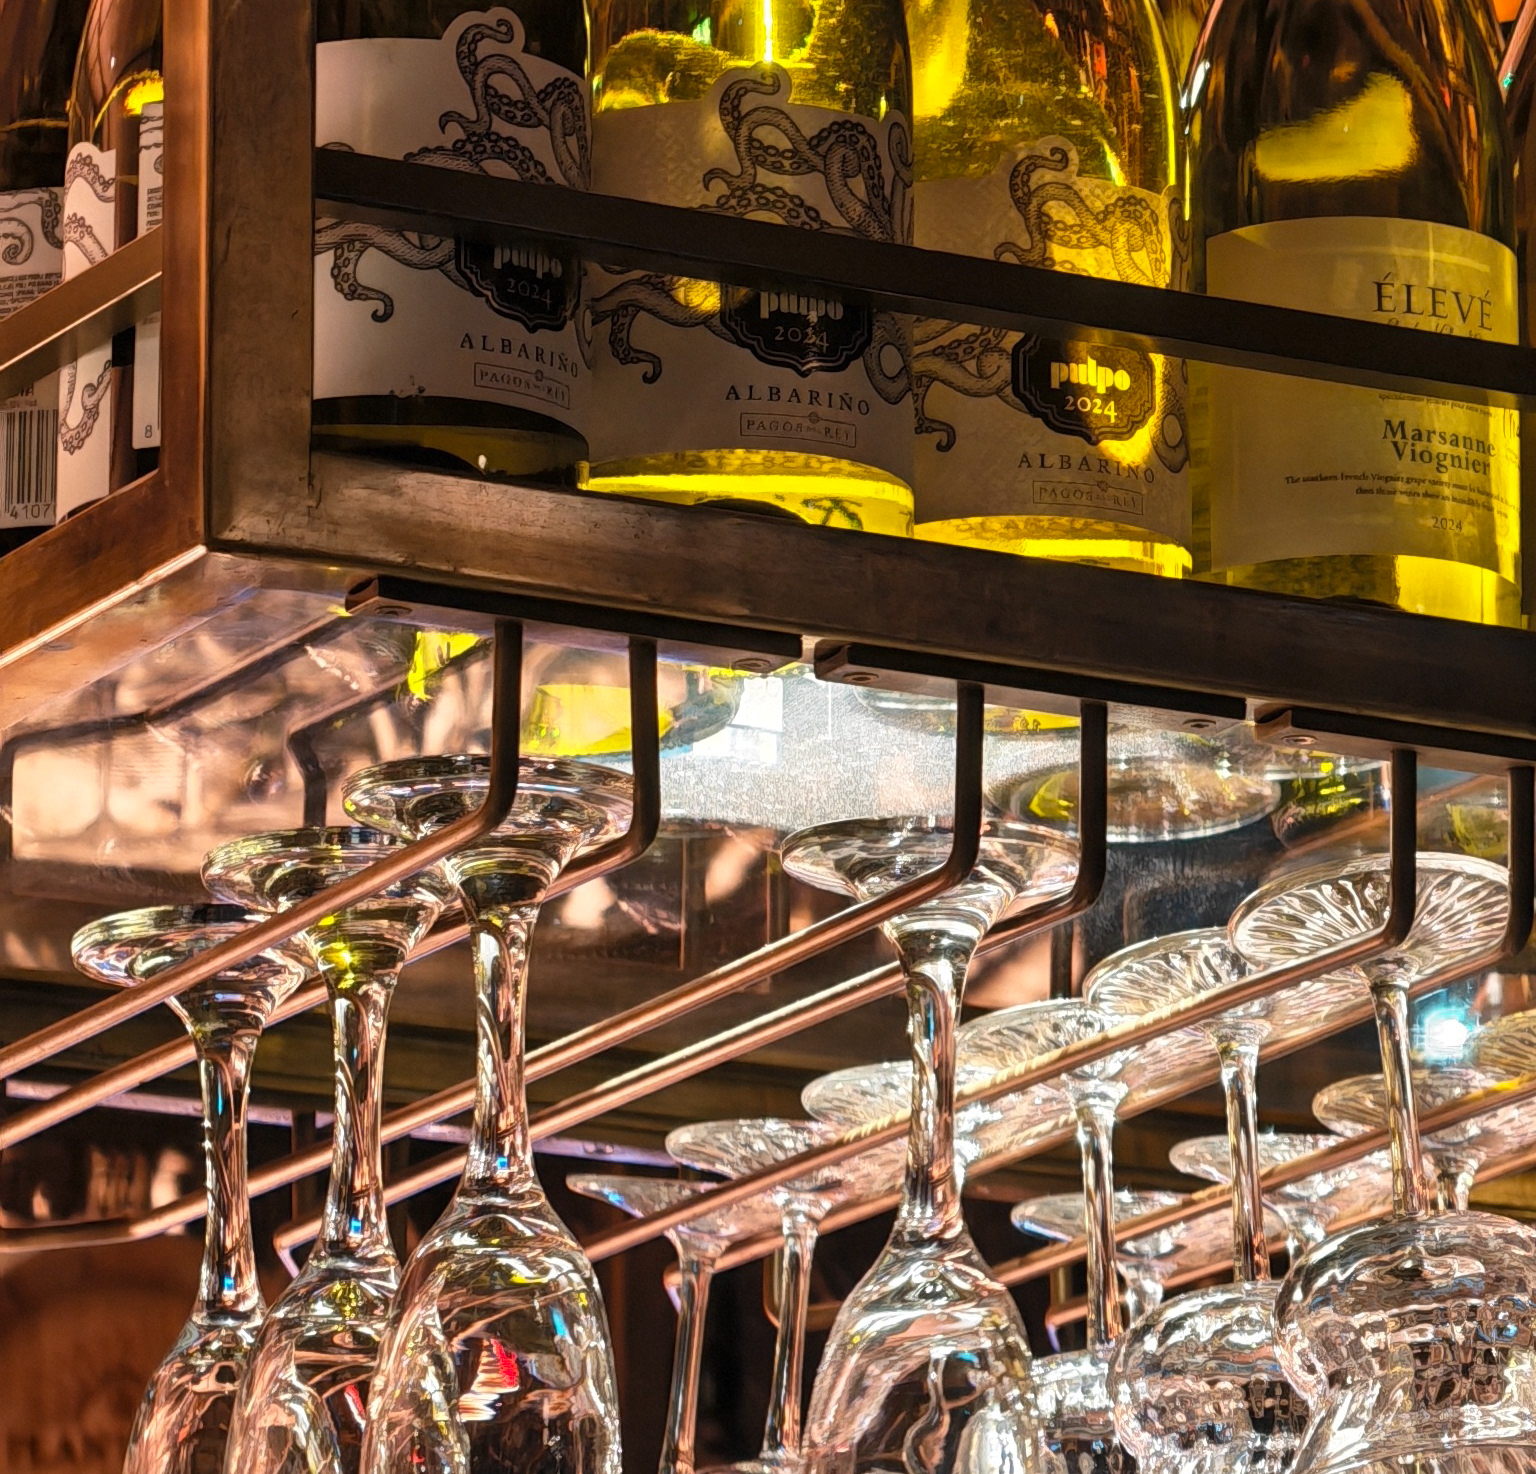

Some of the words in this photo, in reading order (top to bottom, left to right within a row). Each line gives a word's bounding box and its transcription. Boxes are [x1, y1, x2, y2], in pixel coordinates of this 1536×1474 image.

[506, 277, 553, 312] 2024
[1371, 271, 1493, 332] ÉLEVÉ
[459, 332, 579, 379] ALBARIÑO
[1050, 355, 1132, 395] pulpo
[724, 384, 871, 416] ALBARIÑO
[1063, 394, 1118, 424] 2024
[144, 424, 153, 439] 8
[1381, 418, 1497, 458] Marsanne
[1017, 451, 1155, 484] ALBARIÑO
[1390, 440, 1492, 475] Viognier
[9, 501, 56, 521] 4107
[1431, 515, 1463, 533] 2024
